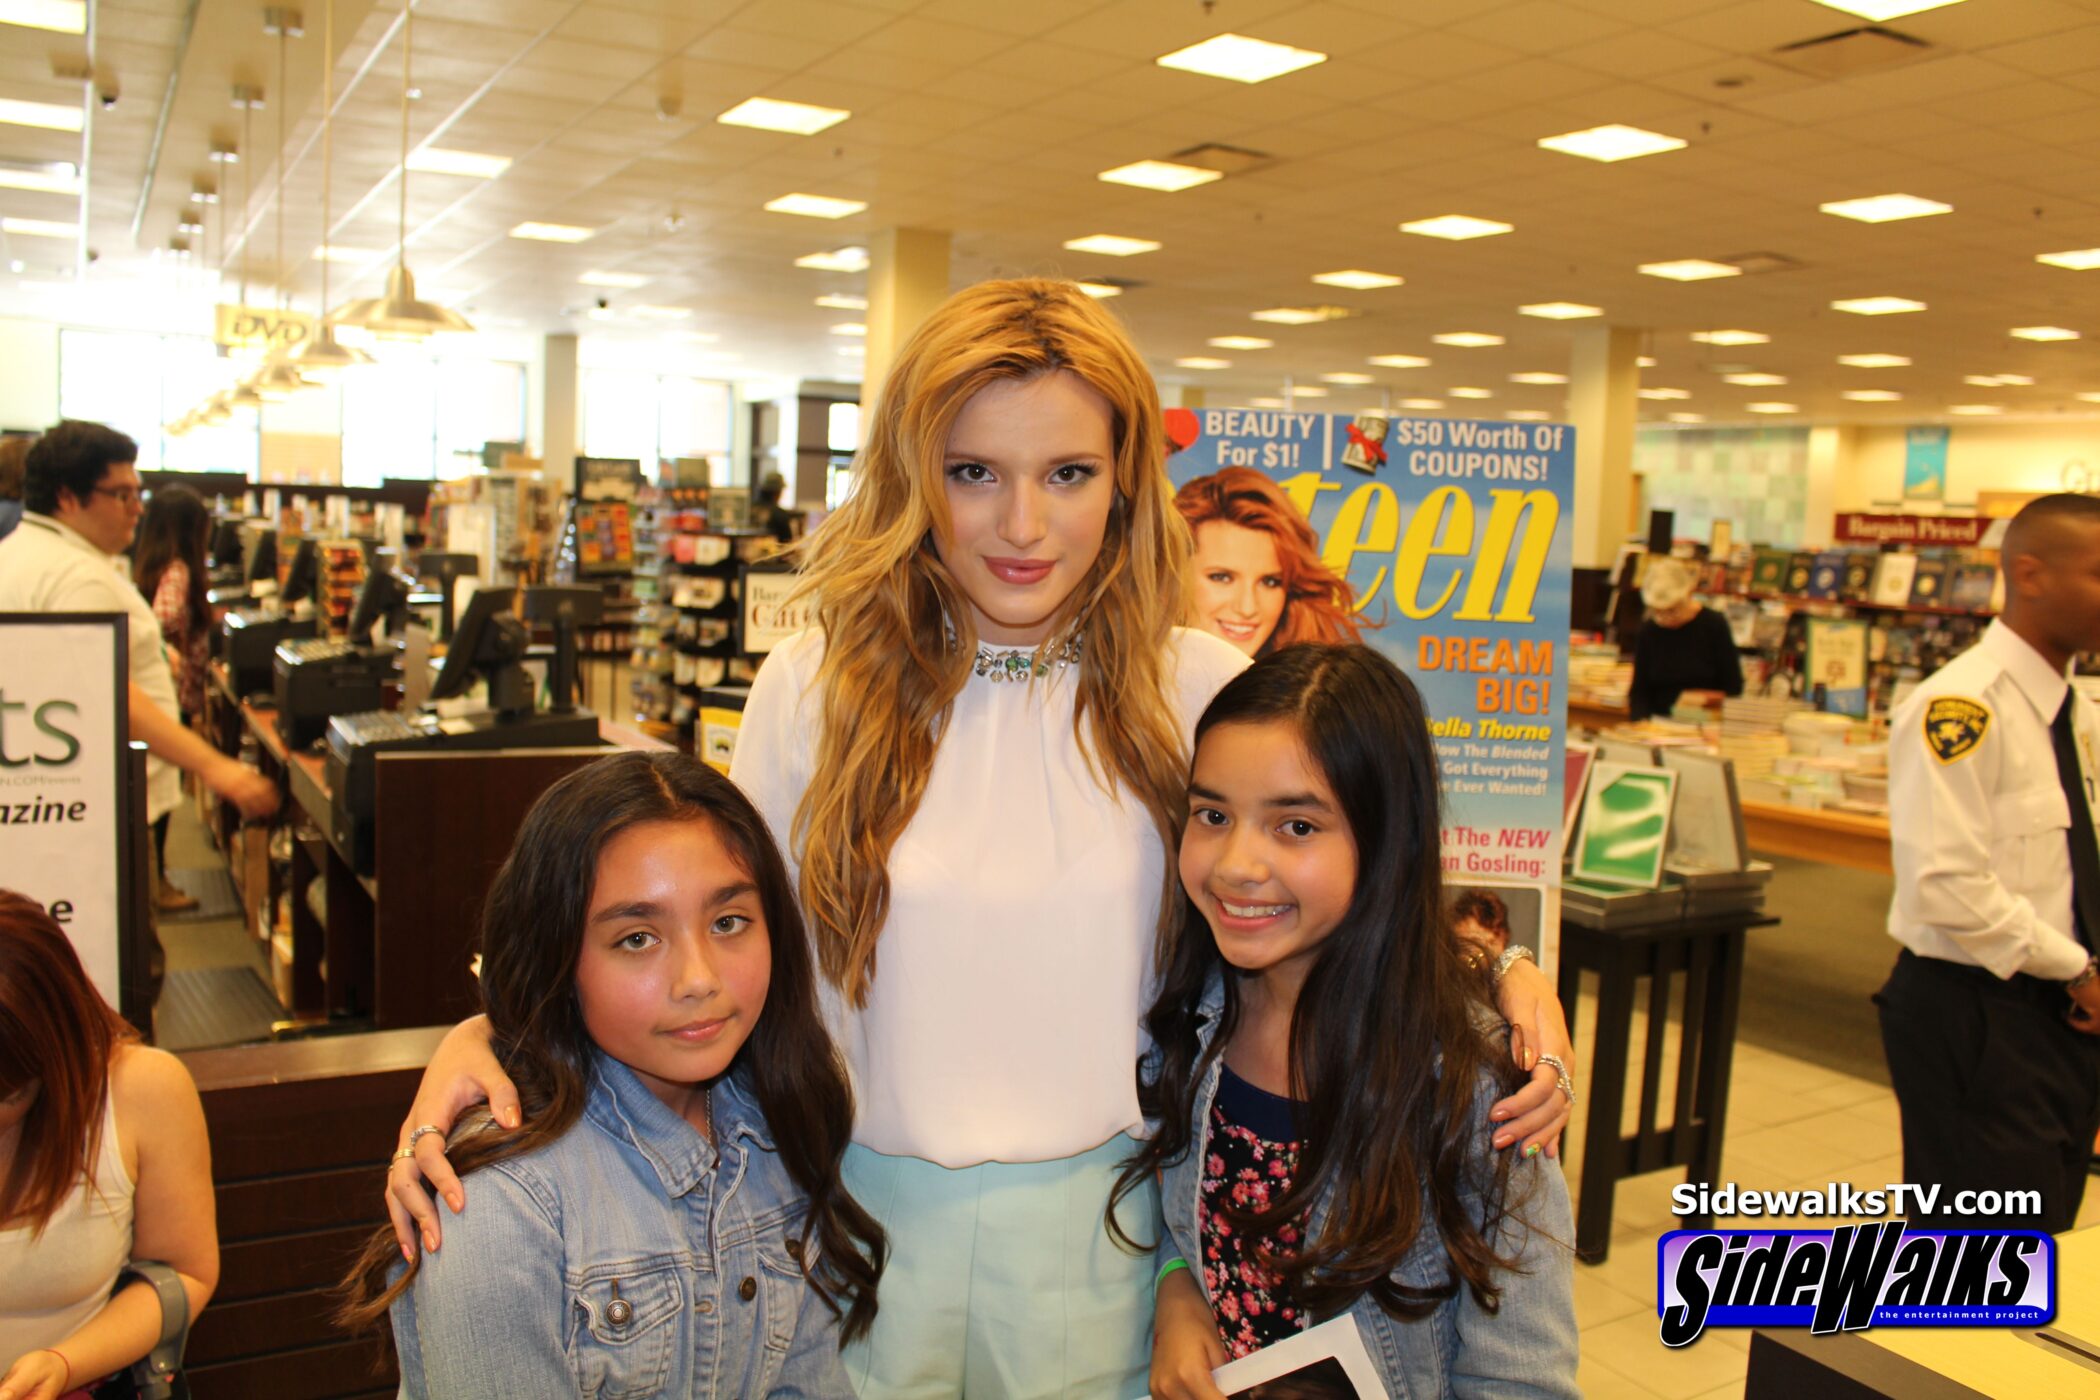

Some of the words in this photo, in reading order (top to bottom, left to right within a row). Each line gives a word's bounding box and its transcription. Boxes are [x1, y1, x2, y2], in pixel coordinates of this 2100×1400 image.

[1205, 411, 1315, 440] BEAUTY
[1397, 421, 1443, 446] $50
[1450, 422, 1527, 449] Worth
[1534, 425, 1564, 452] Of
[1217, 441, 1257, 466] For
[1263, 442, 1300, 468] $1!
[1409, 450, 1549, 481] COUPONS!
[1849, 515, 1915, 543] Bargain
[1918, 520, 1978, 541] Priced
[1278, 471, 1561, 624] teen
[1418, 635, 1554, 676] DREAM
[1476, 678, 1551, 715] BIG!
[1478, 719, 1551, 742] Thorne
[1464, 744, 1489, 758] The
[1491, 745, 1550, 762] Blended
[1443, 761, 1469, 775] Got
[1472, 763, 1549, 781] Everything
[1454, 779, 1484, 793] Ever
[1488, 781, 1548, 797] Wanted!
[1454, 826, 1490, 847] The
[1498, 829, 1550, 849] NEW
[1439, 856, 1460, 871] an
[1467, 853, 1546, 878] Gosling:
